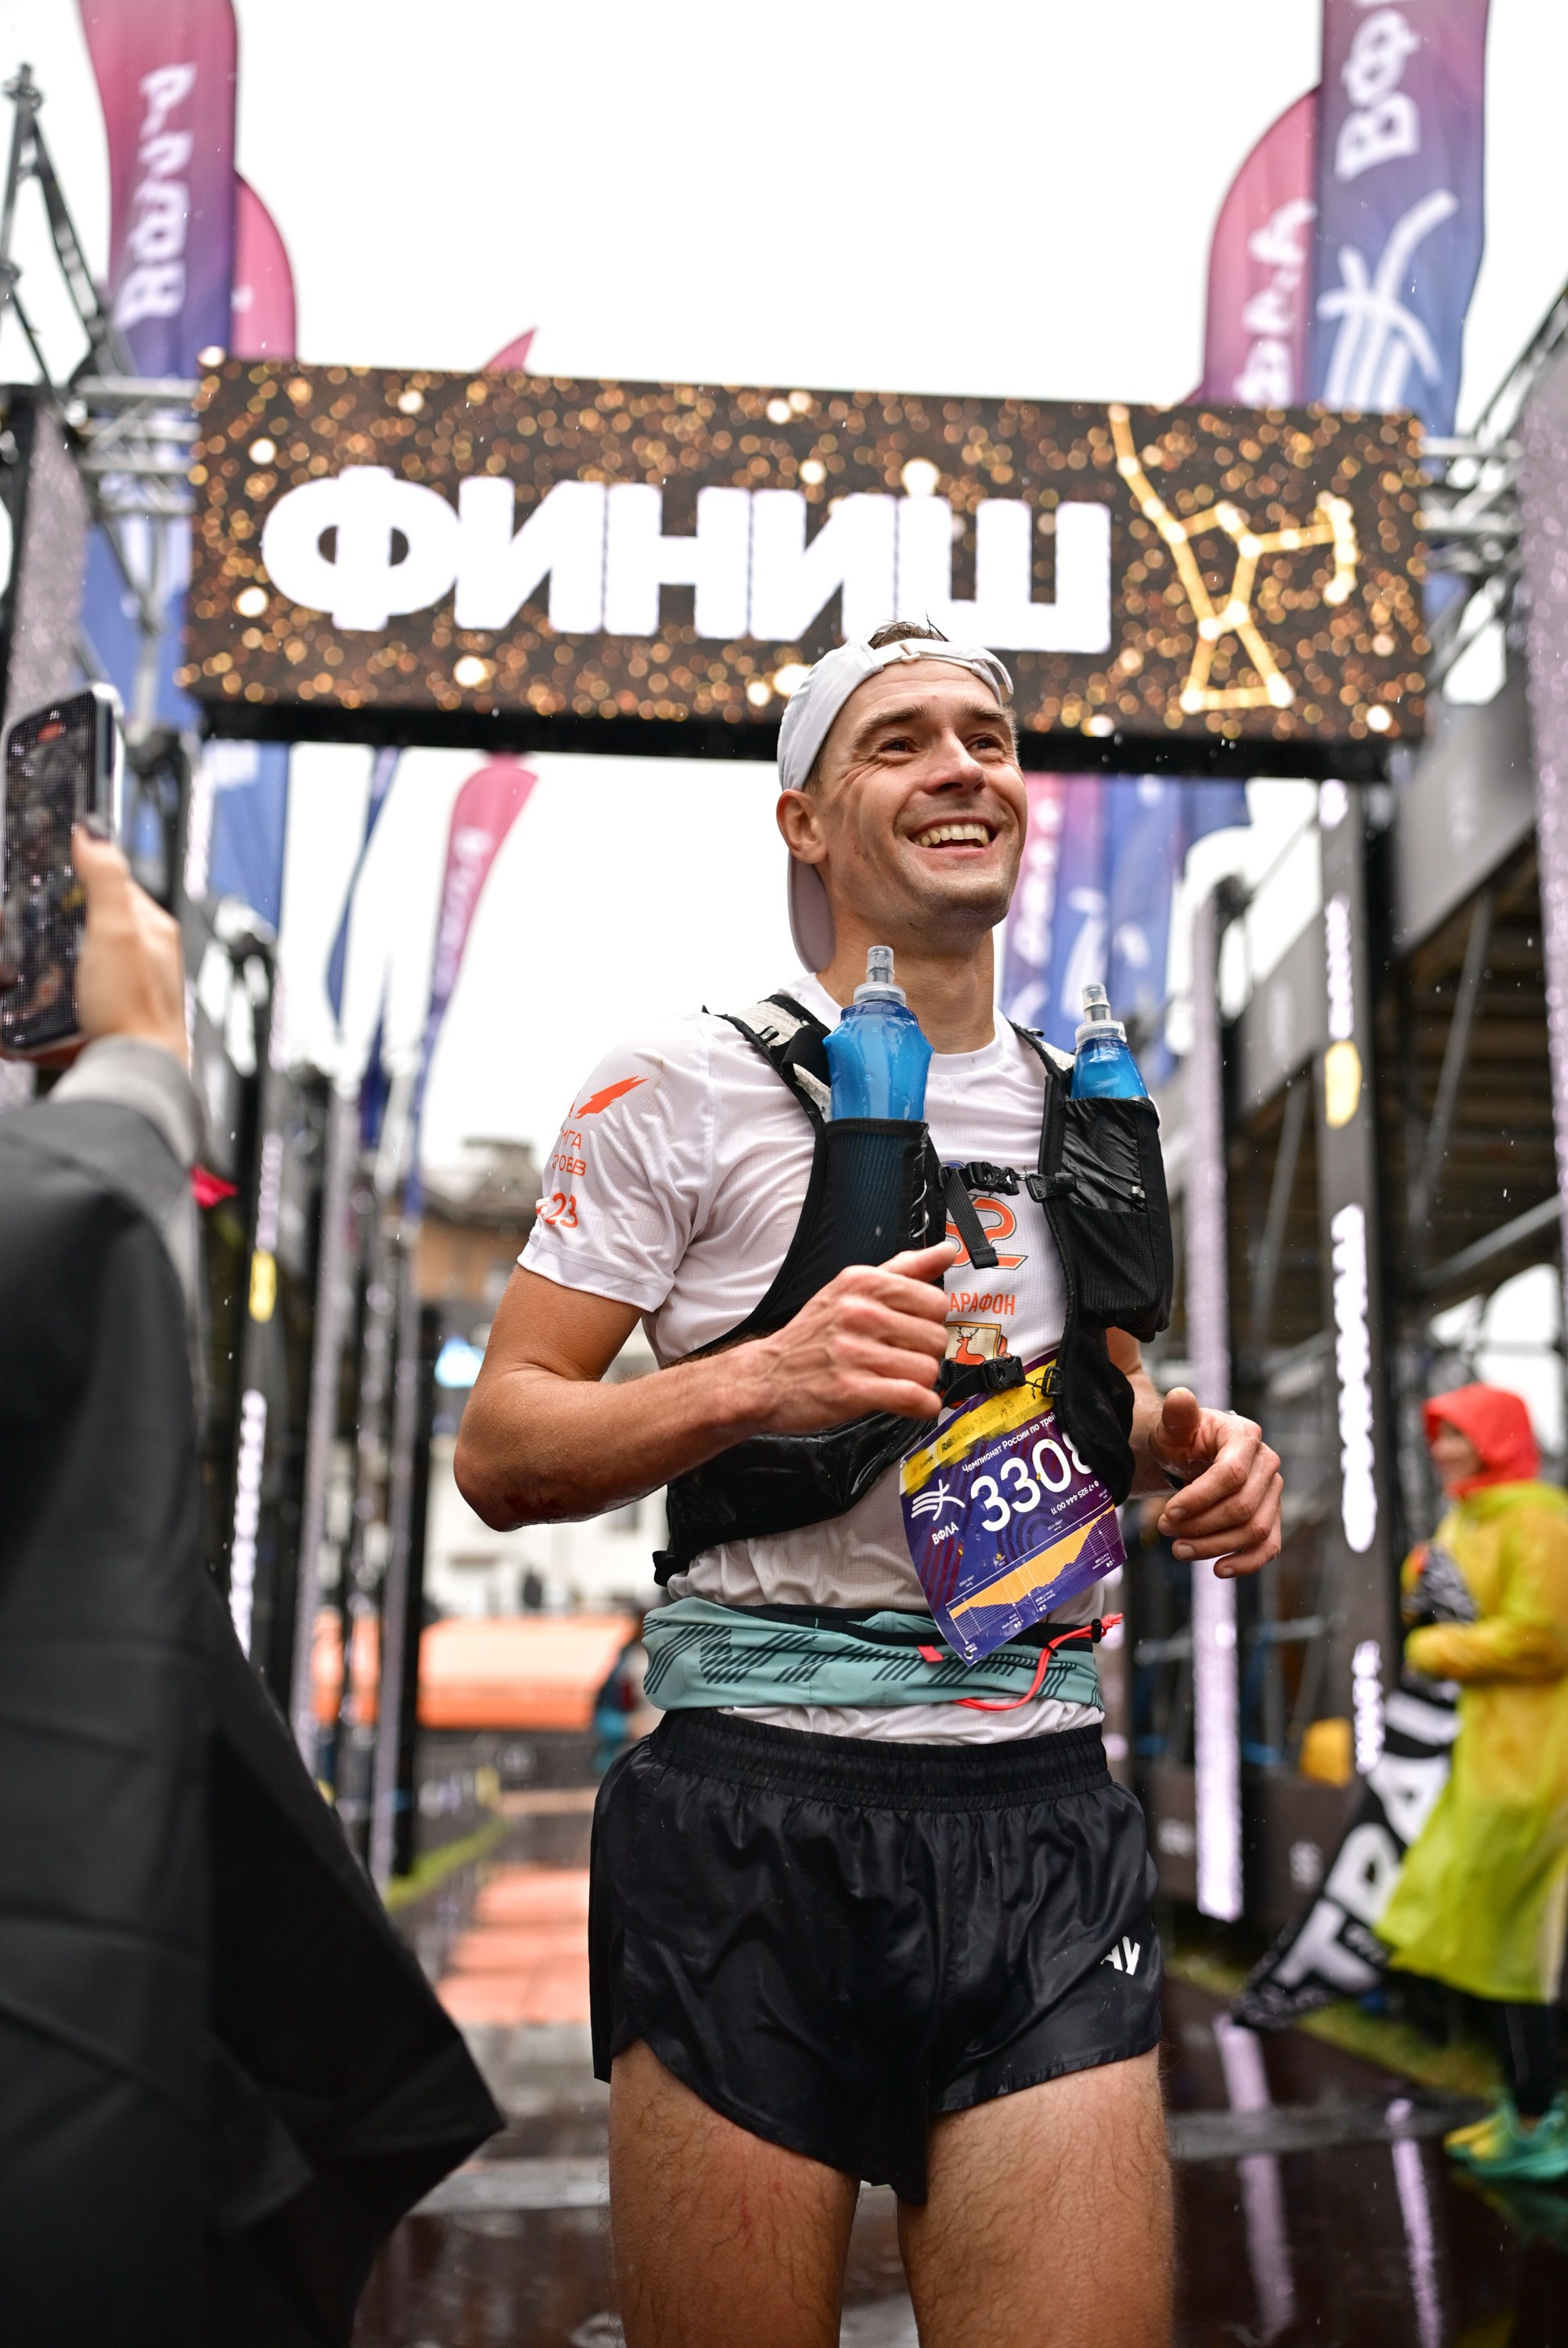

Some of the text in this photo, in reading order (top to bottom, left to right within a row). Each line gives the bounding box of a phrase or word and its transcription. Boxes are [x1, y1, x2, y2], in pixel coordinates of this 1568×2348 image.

[1333, 0, 1422, 183] ВФ
[261, 465, 1112, 654] ФИНИШ
[944, 1291, 1016, 1316] АРАФОН
[962, 1445, 1002, 1473] Чемпионат
[1002, 1429, 1030, 1449] России
[1029, 1424, 1040, 1434] по
[1066, 1495, 1078, 1506] 444
[1077, 1487, 1089, 1498] 925
[1056, 1501, 1066, 1511] 00
[931, 1521, 960, 1546] ВФЛА
